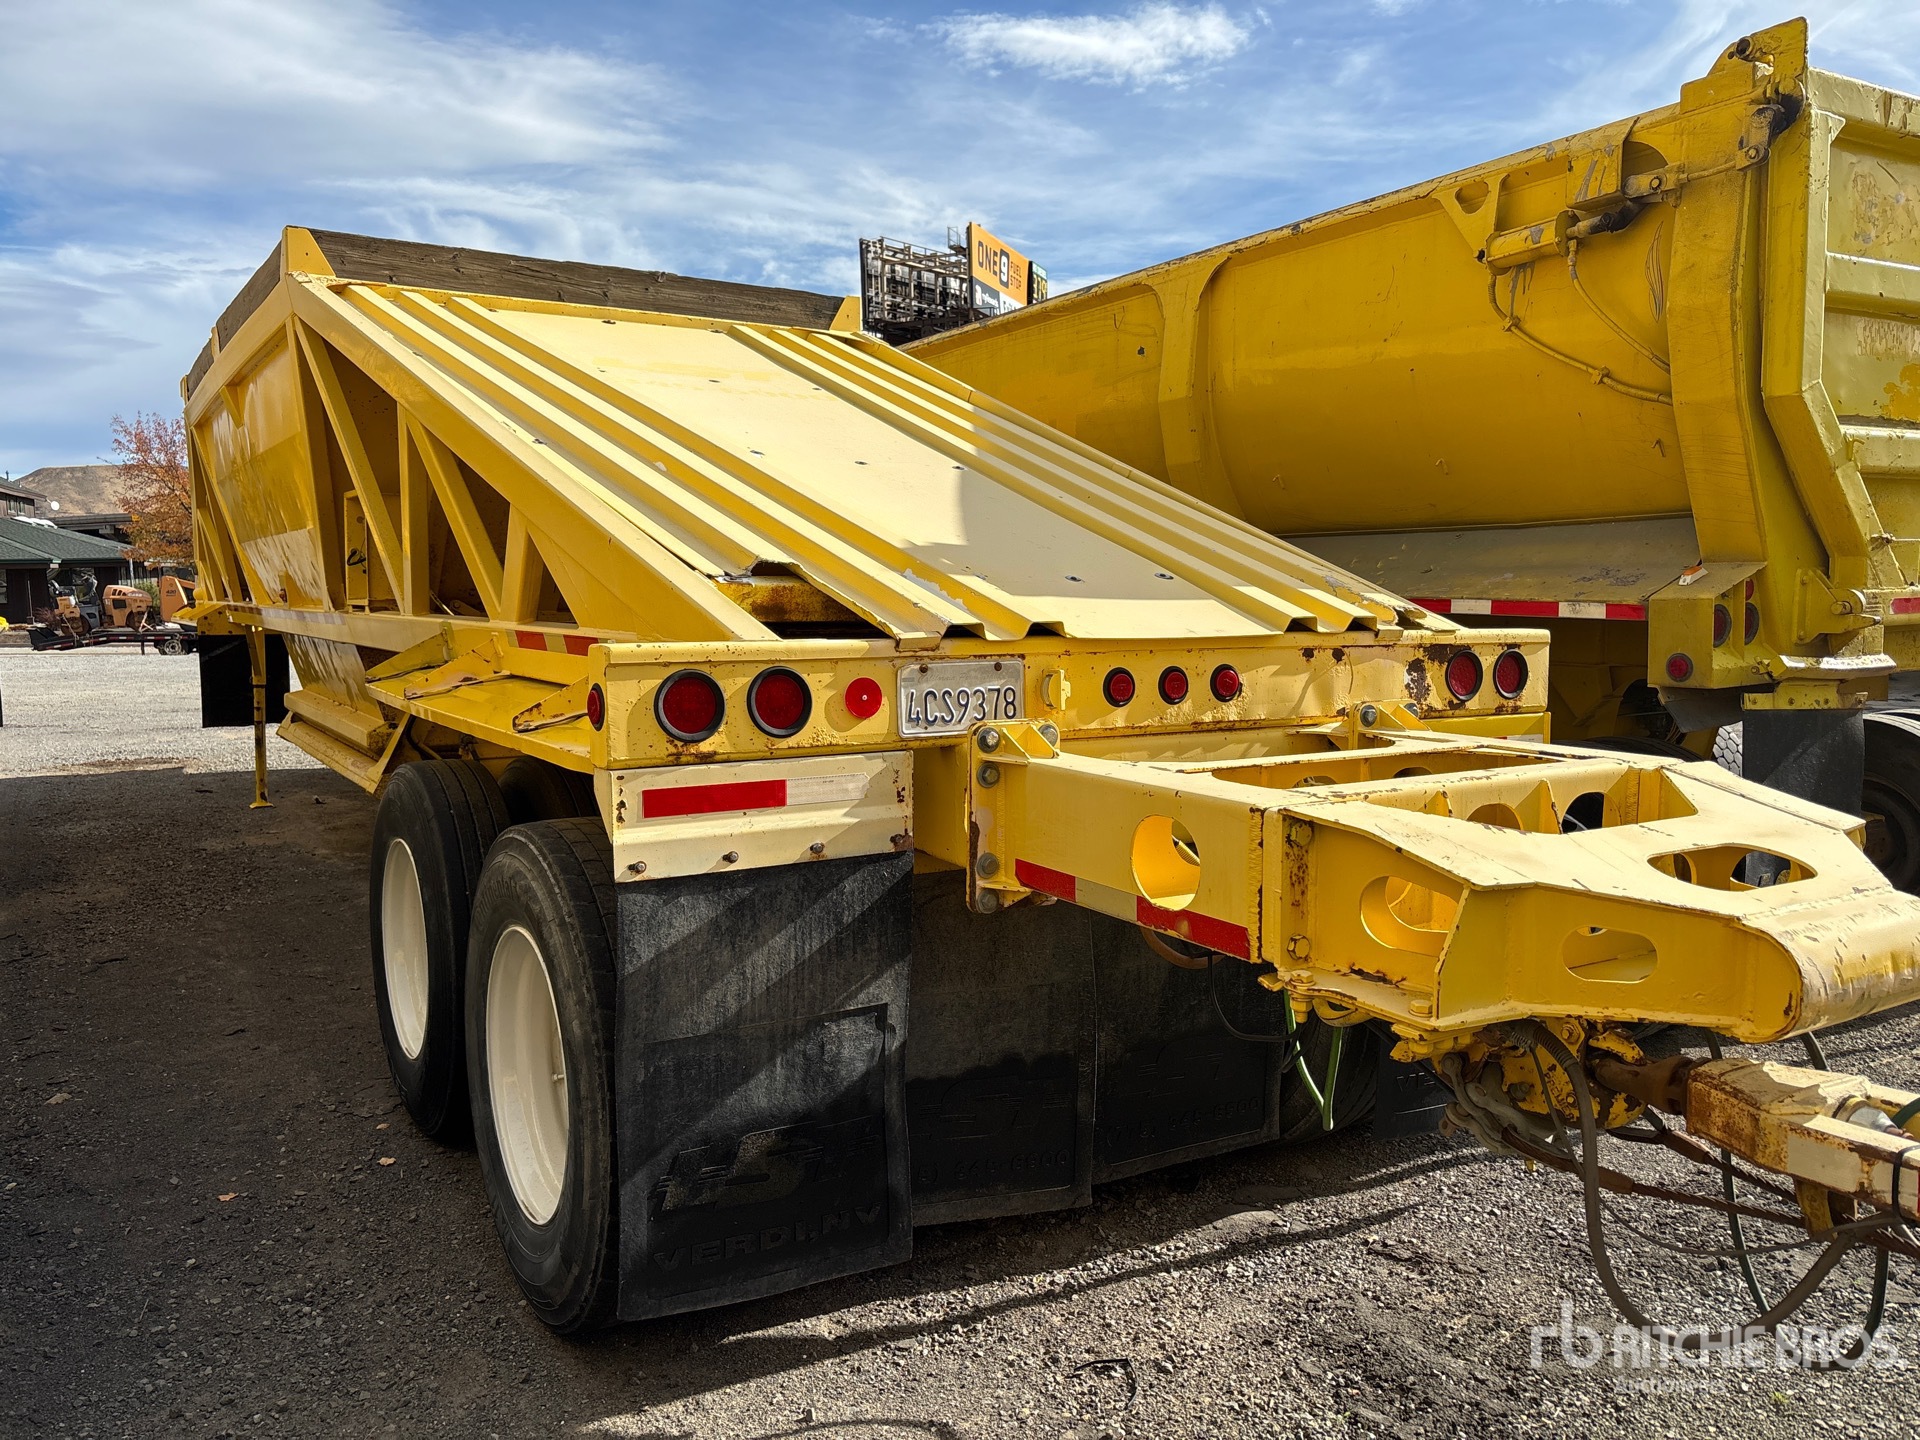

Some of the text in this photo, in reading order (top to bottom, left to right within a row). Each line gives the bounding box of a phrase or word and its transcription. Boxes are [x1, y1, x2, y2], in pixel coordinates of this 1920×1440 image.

[977, 240, 999, 276] ONE
[1010, 261, 1022, 279] FUEL
[1010, 274, 1022, 291] STOP
[908, 686, 1017, 726] 4CS9378
